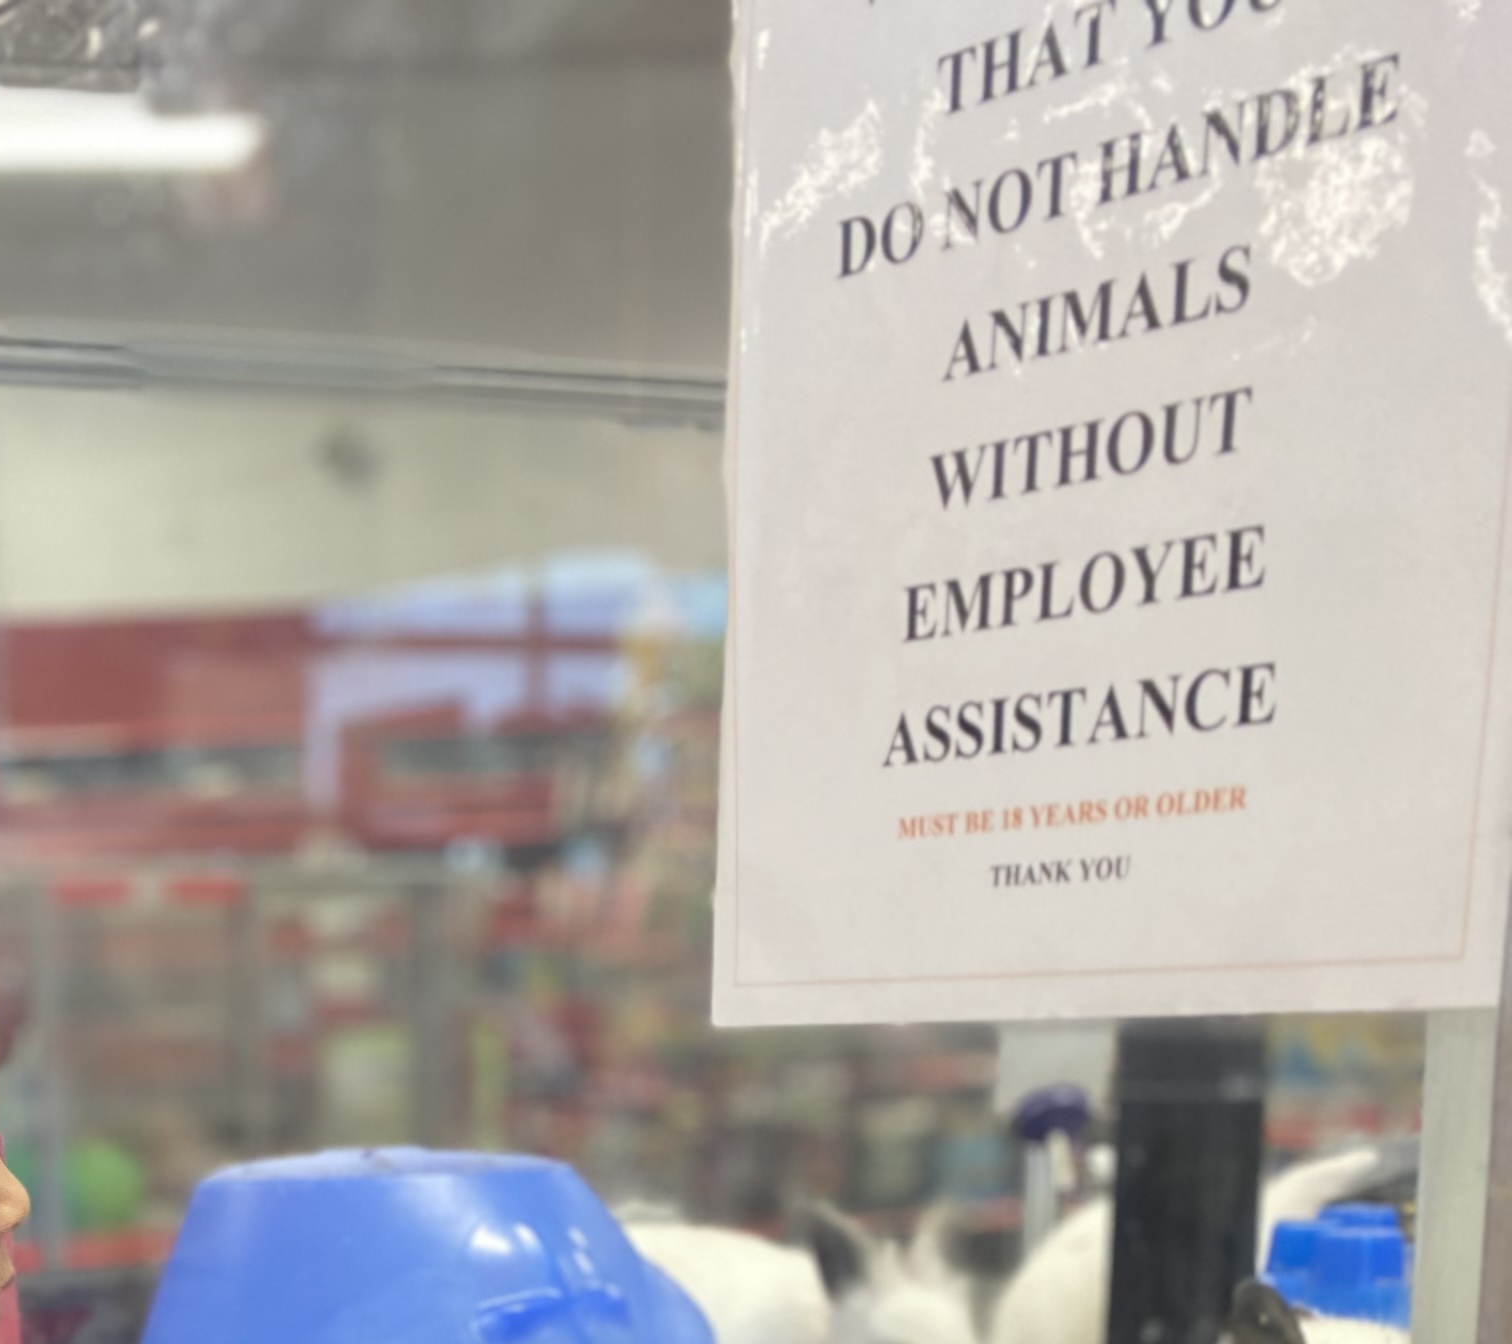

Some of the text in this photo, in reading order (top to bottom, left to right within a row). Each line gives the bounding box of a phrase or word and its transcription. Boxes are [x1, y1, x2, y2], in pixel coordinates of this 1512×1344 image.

[937, 0, 1123, 115] THAT
[837, 54, 1402, 279] DO NOT HANDLE
[942, 245, 1254, 381] ANIMALS
[928, 386, 1254, 512] WITHOUT
[901, 524, 1268, 644] EMPLOYEE
[882, 661, 1278, 768] ASSISTANCE
[898, 785, 1248, 840] MUST BE 18 YEARS OR OLDER
[990, 855, 1133, 888] THANK YOU
